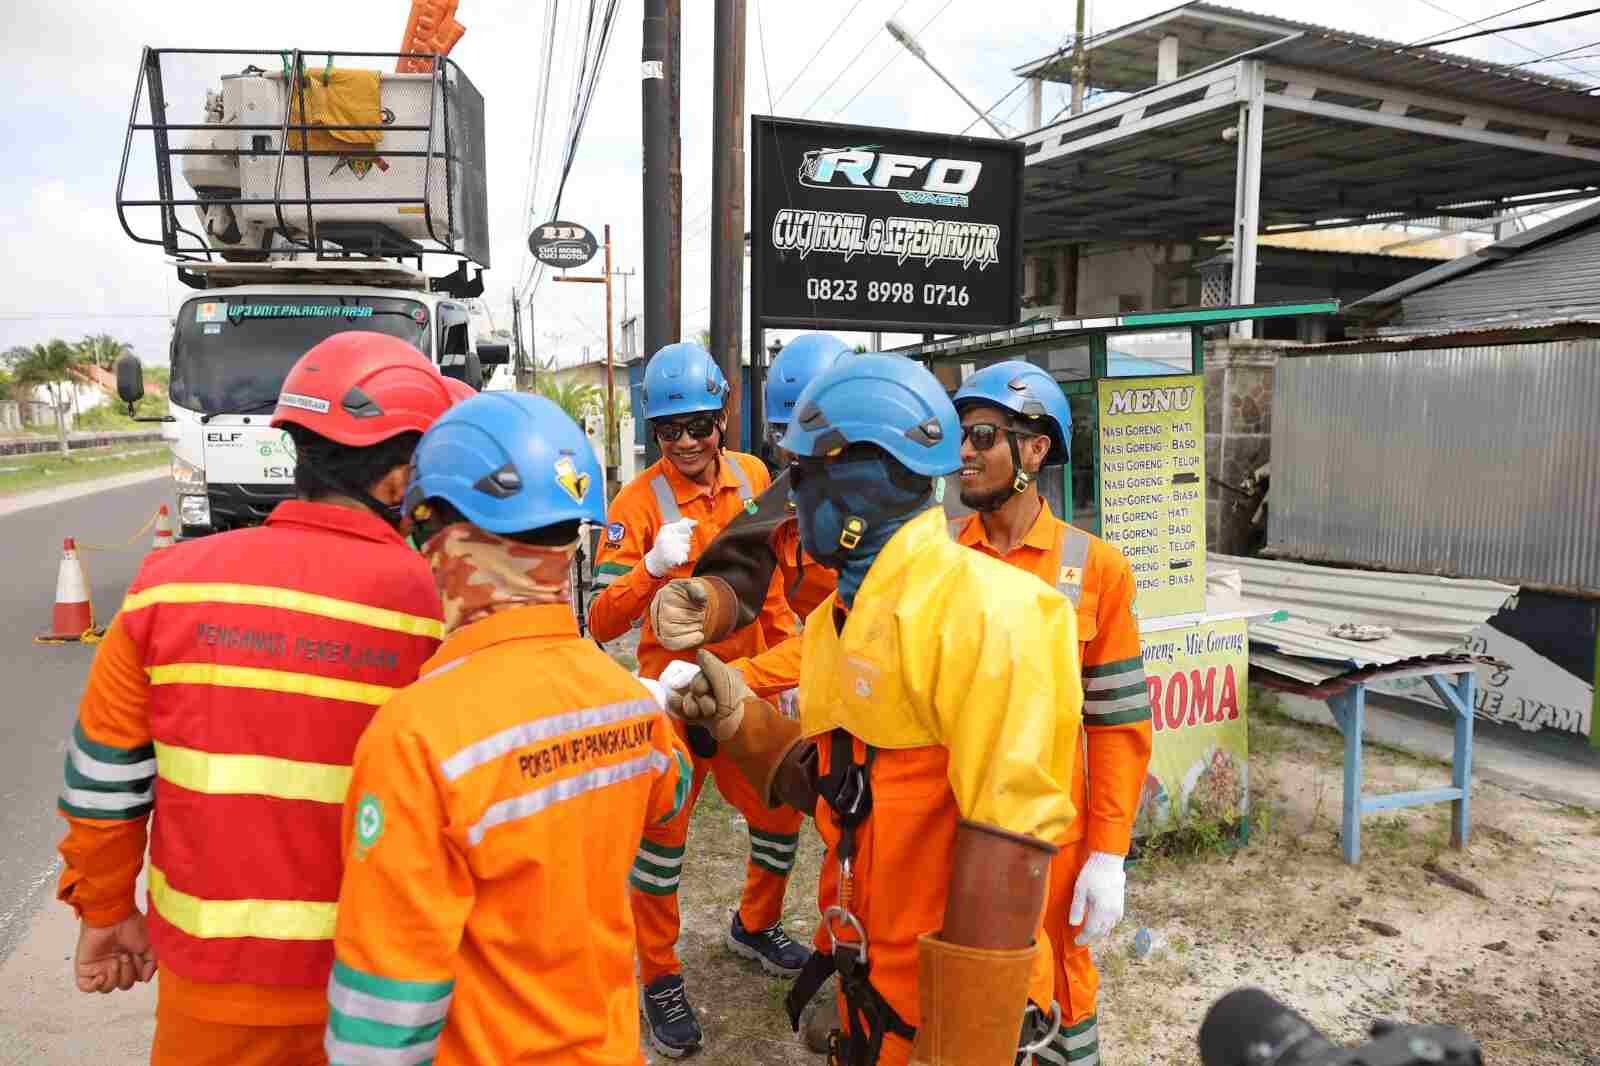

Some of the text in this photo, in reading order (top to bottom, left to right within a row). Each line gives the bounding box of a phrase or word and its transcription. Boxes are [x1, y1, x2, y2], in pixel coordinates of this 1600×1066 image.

[773, 209, 1000, 270] CUCI MOBIL & SEPEDA MOTOR
[807, 279, 970, 306] 0823 8998 0716
[252, 304, 281, 316] UNIT
[1108, 386, 1195, 416] MENU
[207, 433, 243, 442] ELF
[1103, 425, 1123, 437] NASI
[1125, 423, 1162, 435] GORENG
[1172, 422, 1192, 433] HATI
[1103, 444, 1124, 455] NASI
[1126, 442, 1162, 454] GORENG
[1172, 439, 1196, 449] BASO
[1104, 462, 1124, 473] NASI
[1126, 459, 1162, 471] GORENG
[1173, 456, 1200, 467] TELOR
[1104, 480, 1125, 490] NASI
[1127, 477, 1163, 488] GORENG
[1104, 497, 1126, 507] NASI
[1127, 494, 1163, 505] GORENG
[1173, 490, 1200, 501] BIASA
[1105, 513, 1120, 524] MIE
[1122, 511, 1158, 522] GORENG
[1168, 508, 1189, 518] HATI
[1105, 530, 1121, 541] MIE
[1122, 528, 1158, 540] GORENG
[1168, 524, 1192, 535] BASO
[1122, 545, 1159, 557] GORENG
[1169, 541, 1196, 552] TELOR
[1131, 561, 1159, 572] ORENG
[1137, 579, 1159, 589] RENG
[1168, 575, 1194, 586] BIASA
[1185, 632, 1203, 655] Mie
[1207, 630, 1243, 655] Goreng
[1145, 663, 1239, 731] ROMA
